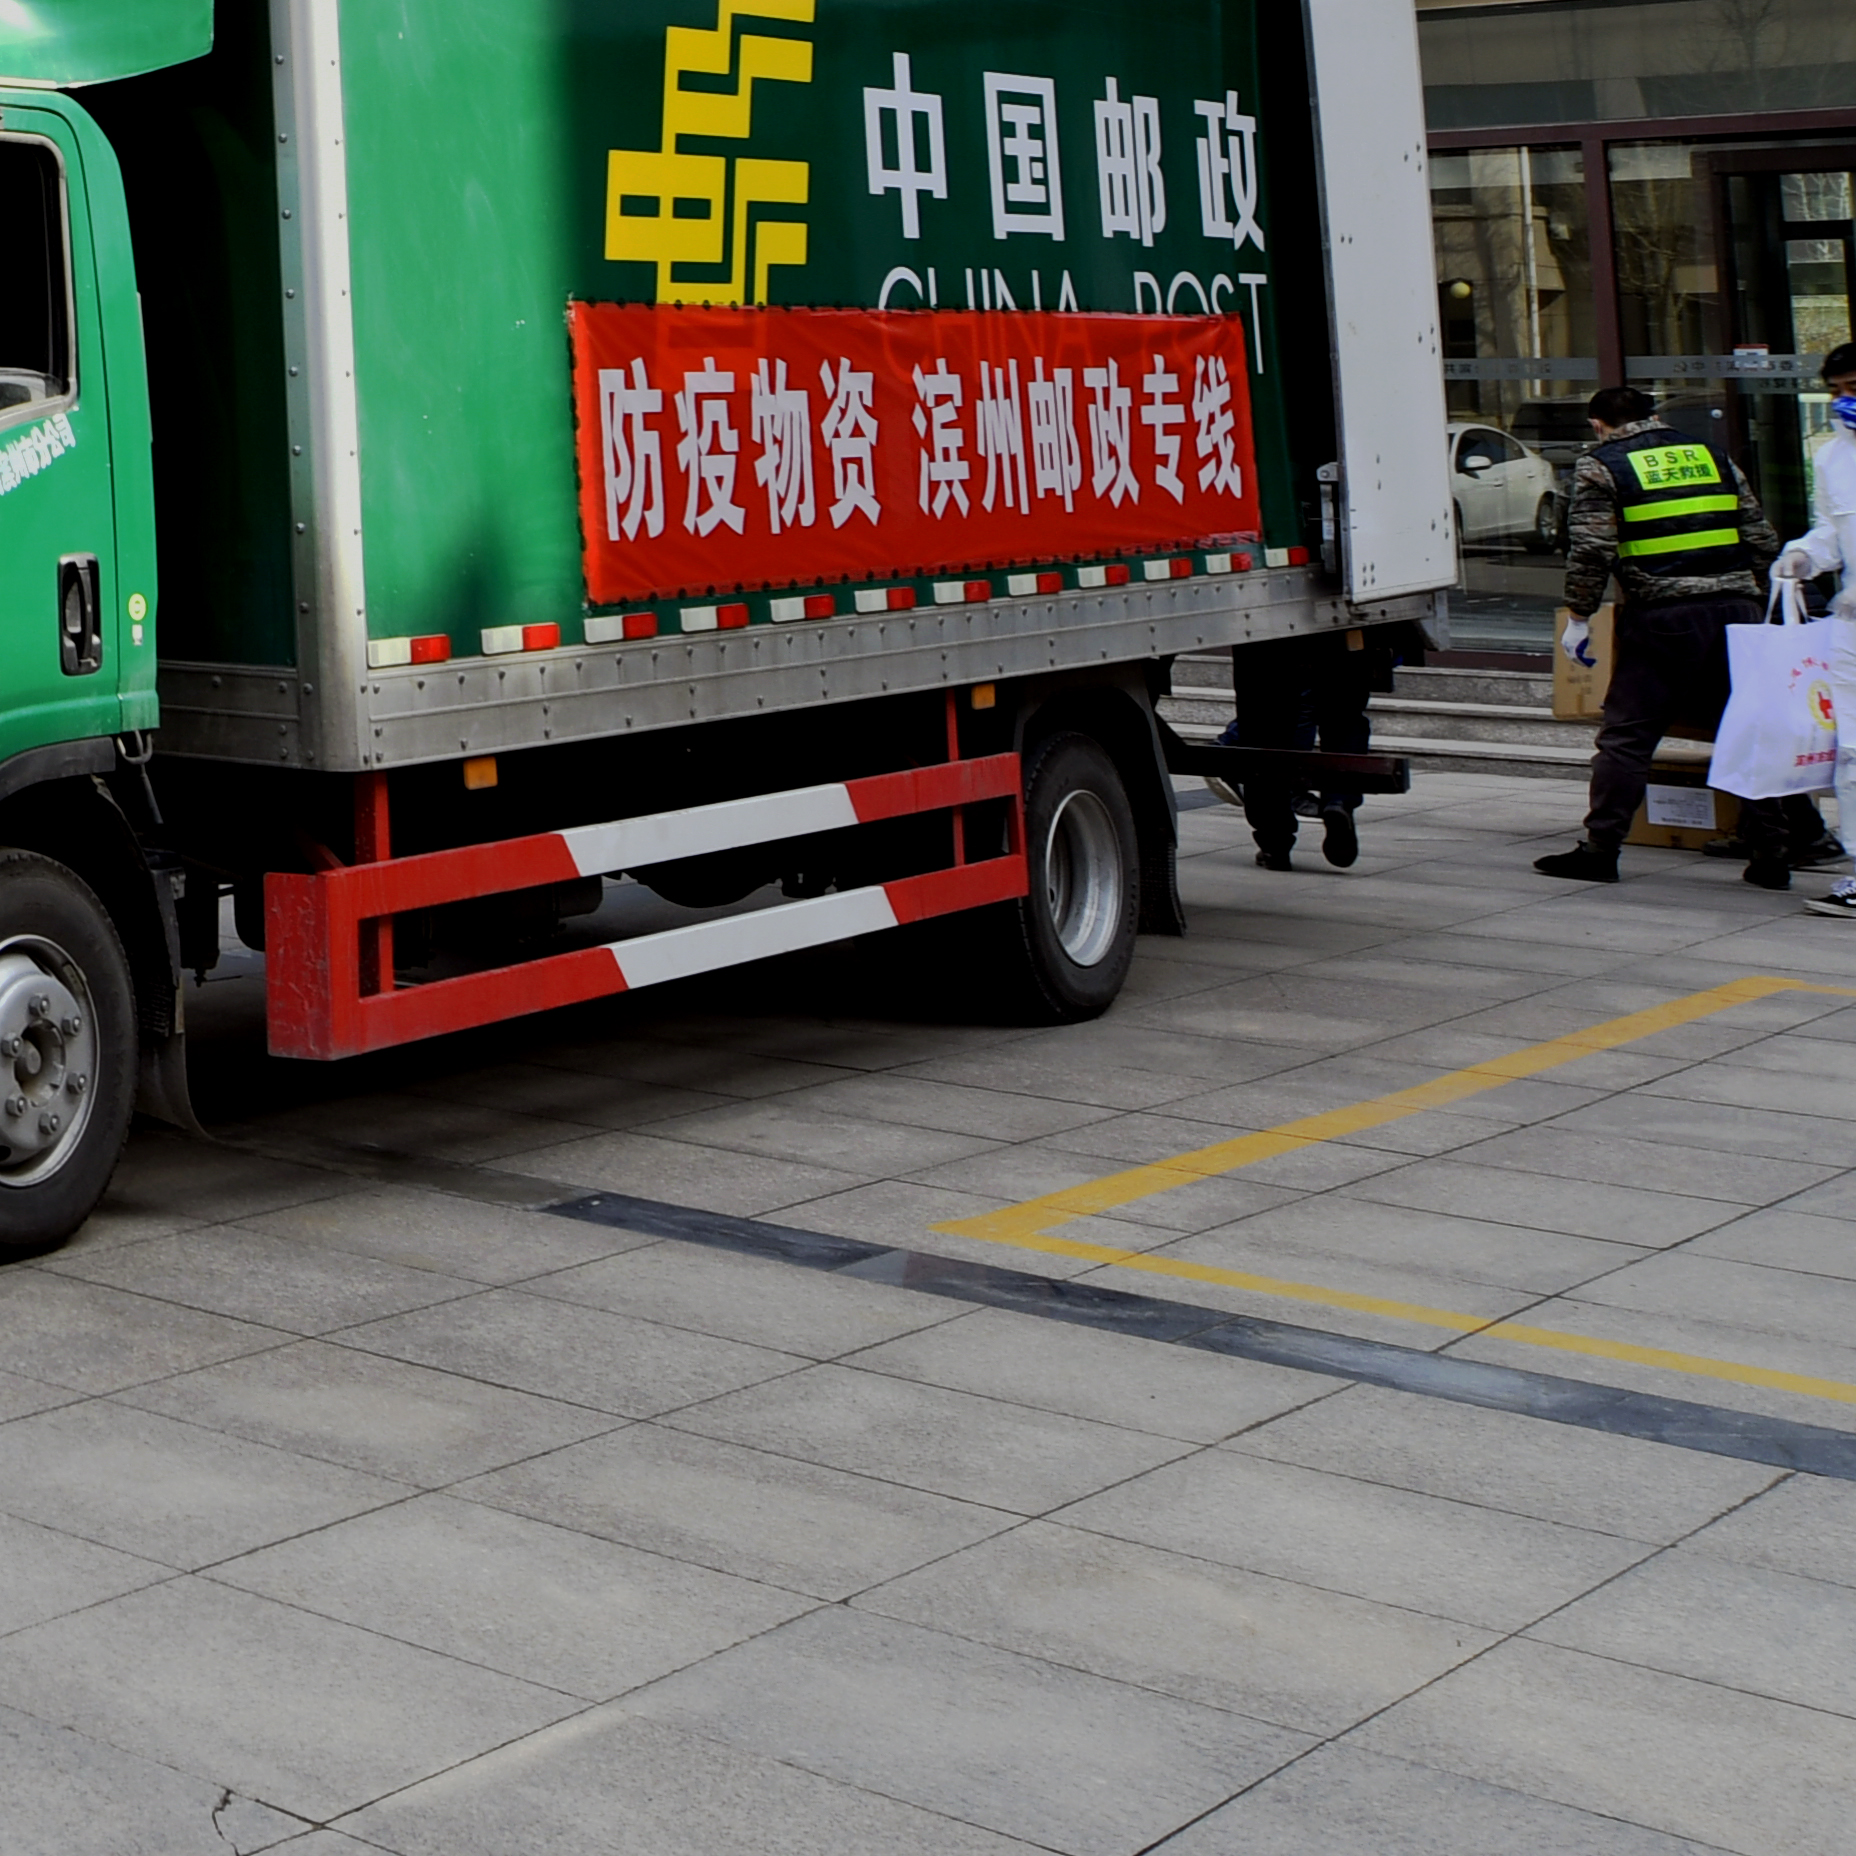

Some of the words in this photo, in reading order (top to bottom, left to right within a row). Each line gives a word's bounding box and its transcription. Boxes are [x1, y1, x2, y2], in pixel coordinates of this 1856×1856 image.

[863, 52, 1265, 252] 中国邮政
[597, 356, 881, 542] 防疫物资
[911, 353, 1242, 519] 滨州邮政专线
[1643, 450, 1699, 467] BSR
[1643, 463, 1713, 485] 蓝天救援
